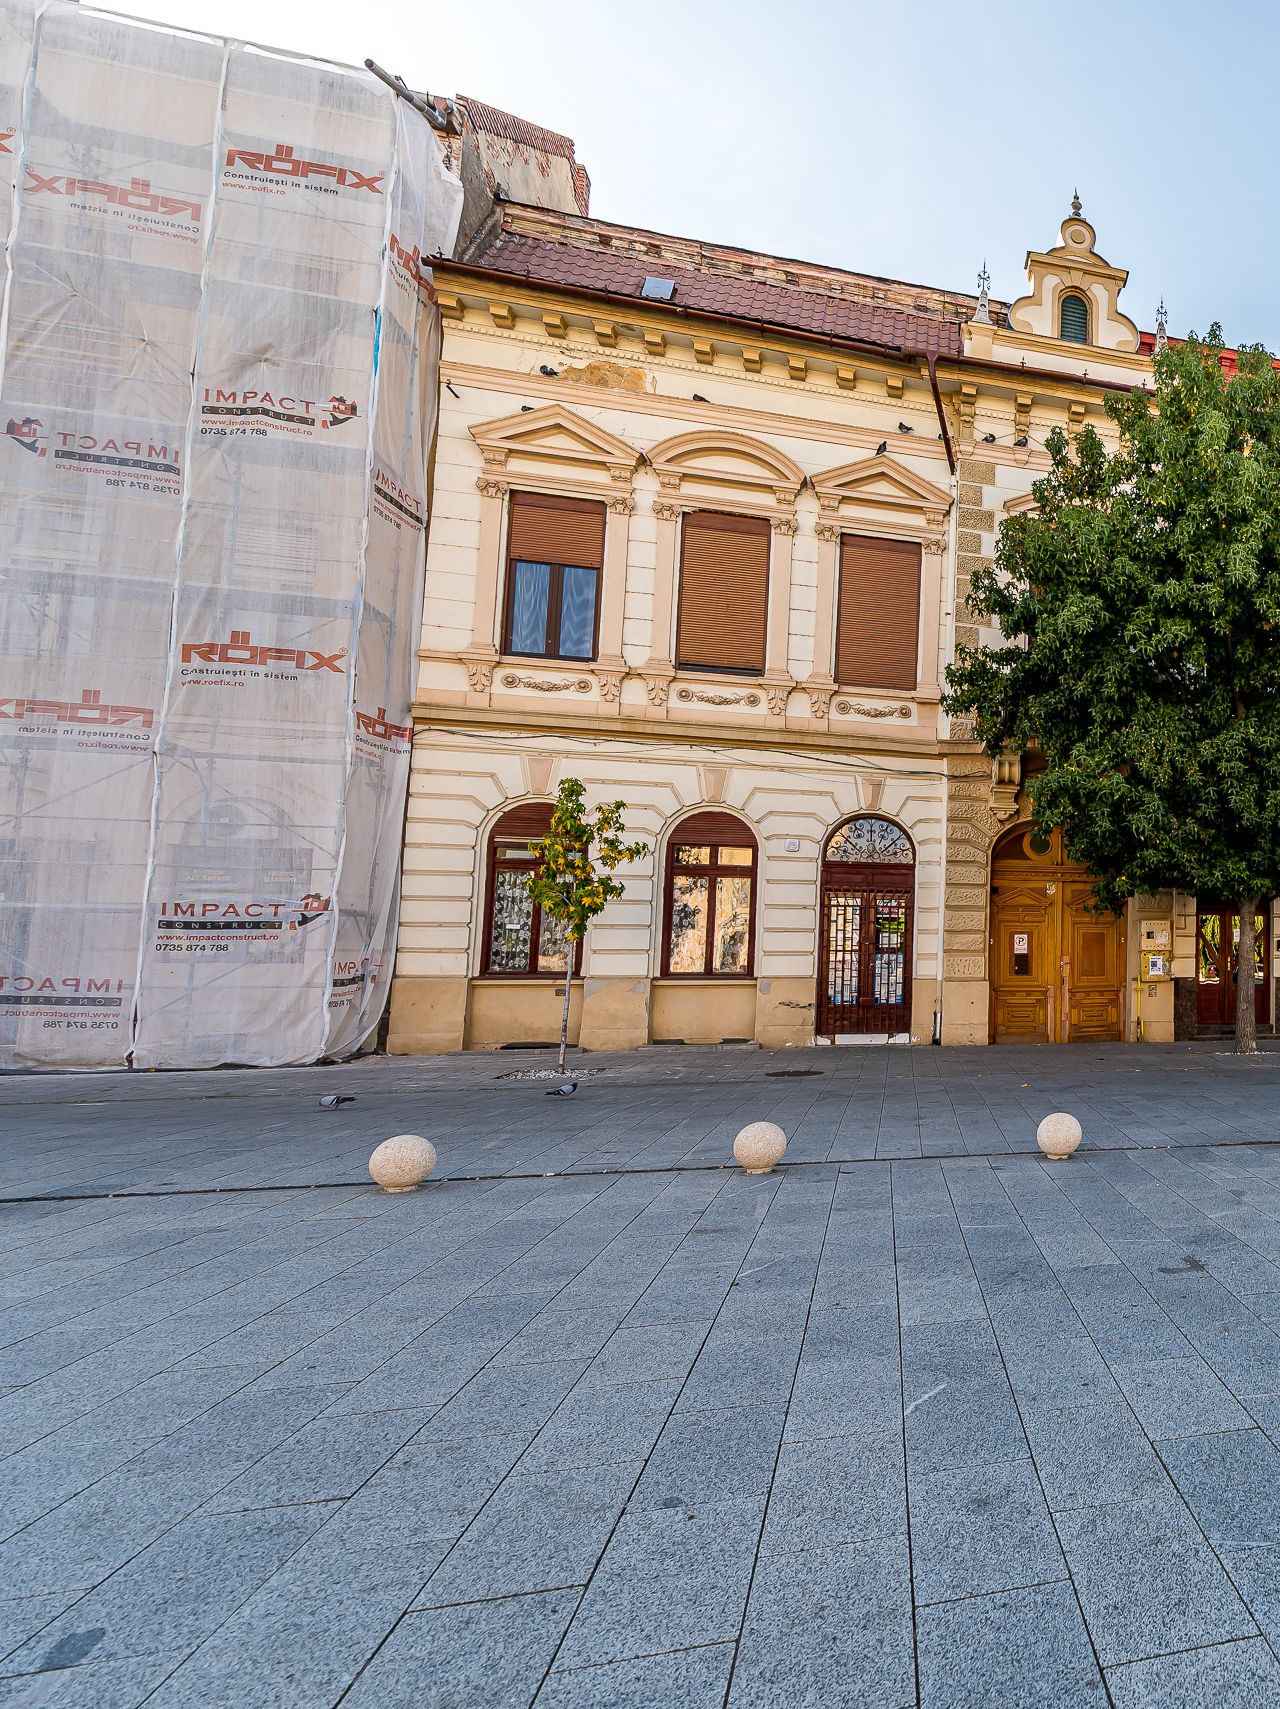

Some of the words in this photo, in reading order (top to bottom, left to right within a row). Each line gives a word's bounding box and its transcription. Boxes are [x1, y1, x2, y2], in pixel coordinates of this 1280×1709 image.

[304, 184, 339, 195] sistem
[204, 388, 316, 414] IMPACT
[203, 406, 314, 425] CONSTRUCT
[200, 427, 227, 436] 0735
[249, 428, 268, 437] 788
[201, 418, 313, 436] www.impactconstruct.ro
[376, 469, 421, 513] IMPACT
[264, 671, 298, 681] sistem
[161, 902, 286, 917] IMPACT
[159, 921, 281, 929] CONSTRUCT
[156, 933, 279, 941] www.impactconstruct.ro
[155, 943, 183, 951] 0735
[185, 943, 206, 952] 874
[209, 943, 229, 952] 788
